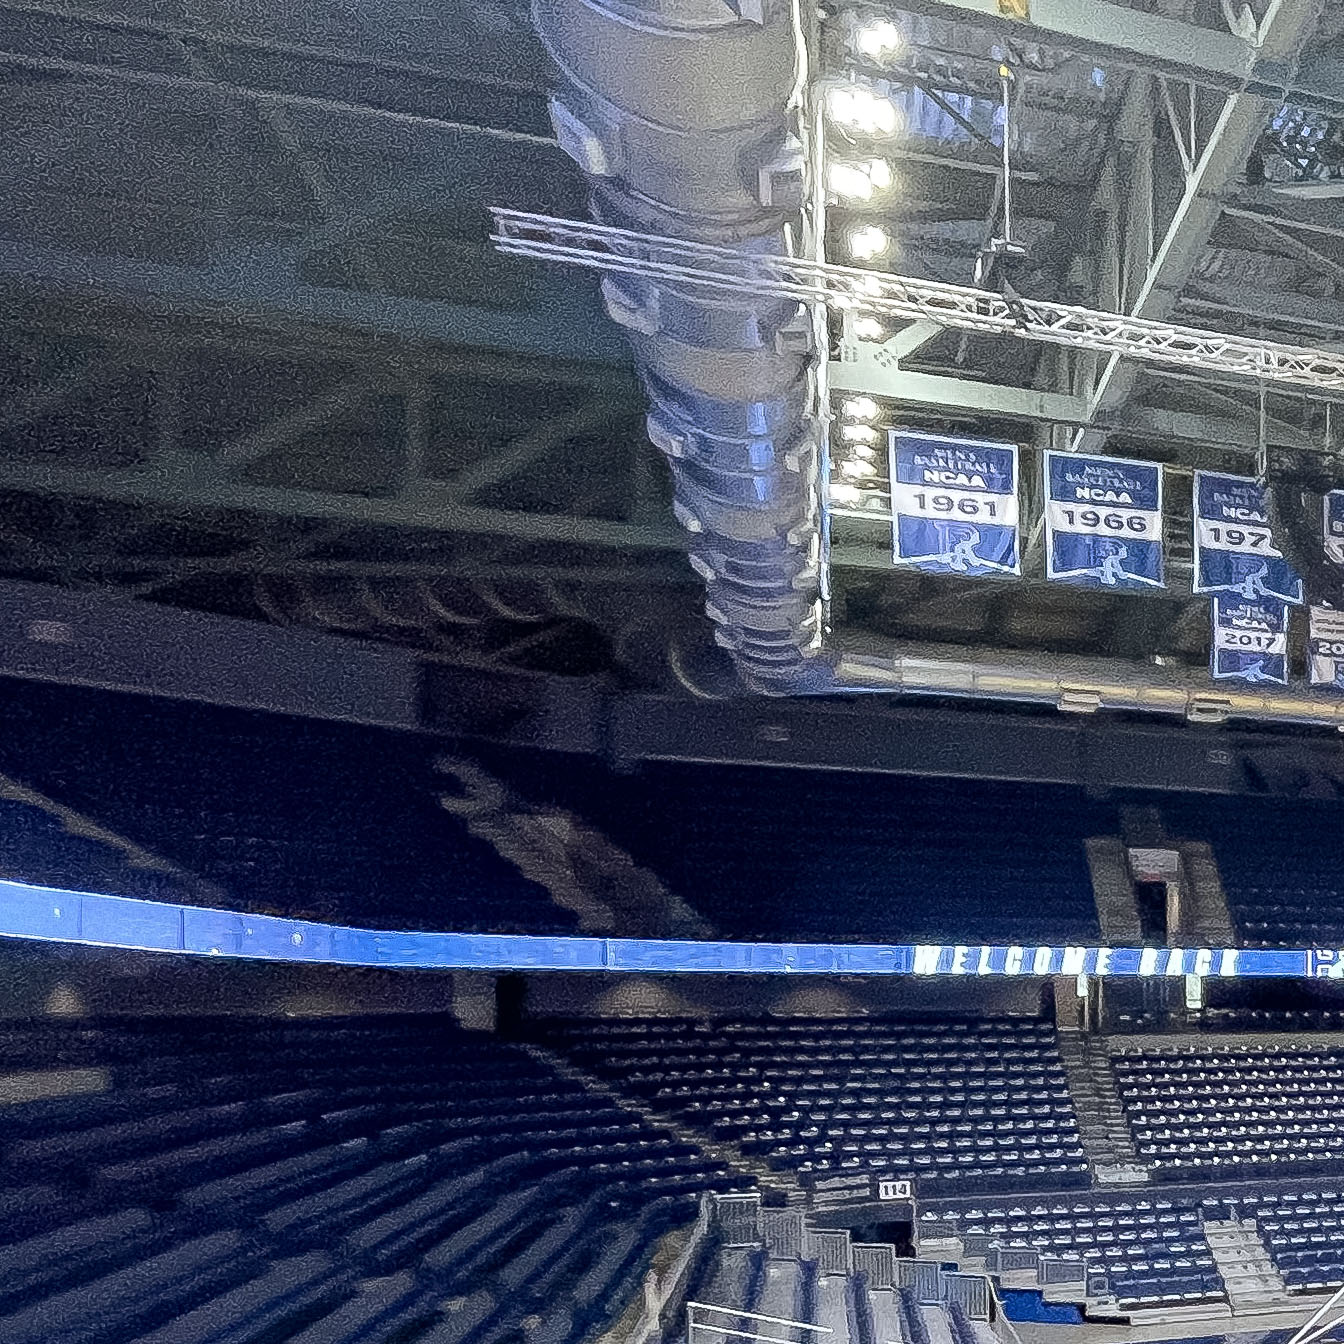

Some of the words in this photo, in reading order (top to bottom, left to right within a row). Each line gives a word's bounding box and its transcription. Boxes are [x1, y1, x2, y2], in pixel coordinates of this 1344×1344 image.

[923, 470, 988, 489] NCAA
[1075, 486, 1133, 503] NCAA
[913, 494, 997, 517] 1961
[1222, 506, 1268, 522] NCA
[1062, 509, 1147, 532] 1966
[1209, 527, 1268, 547] 197
[1224, 632, 1277, 648] 2017
[913, 944, 1115, 975] WELCOME
[1138, 947, 1240, 976] BACK
